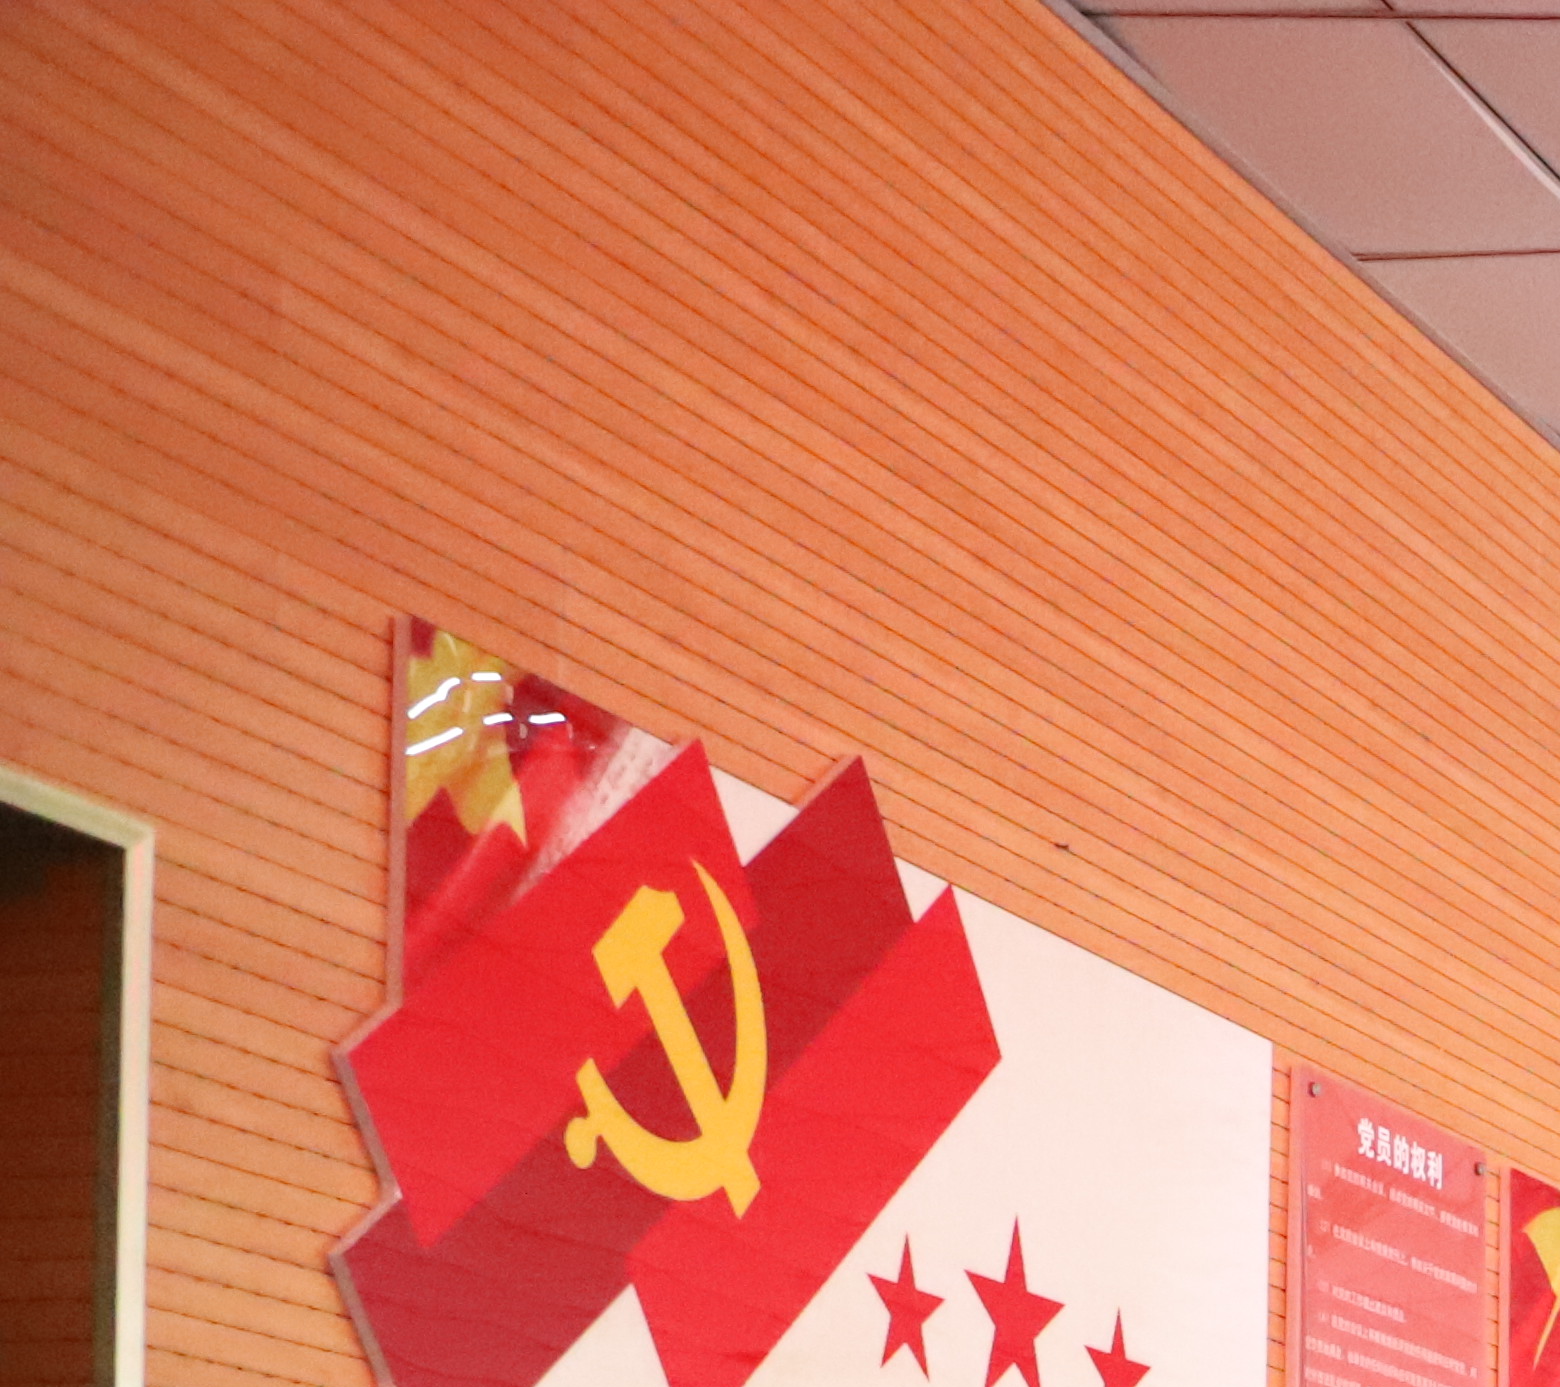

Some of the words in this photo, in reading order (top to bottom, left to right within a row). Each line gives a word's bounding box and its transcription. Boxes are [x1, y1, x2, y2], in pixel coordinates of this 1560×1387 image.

[1357, 1118, 1443, 1190] 党员的权利
